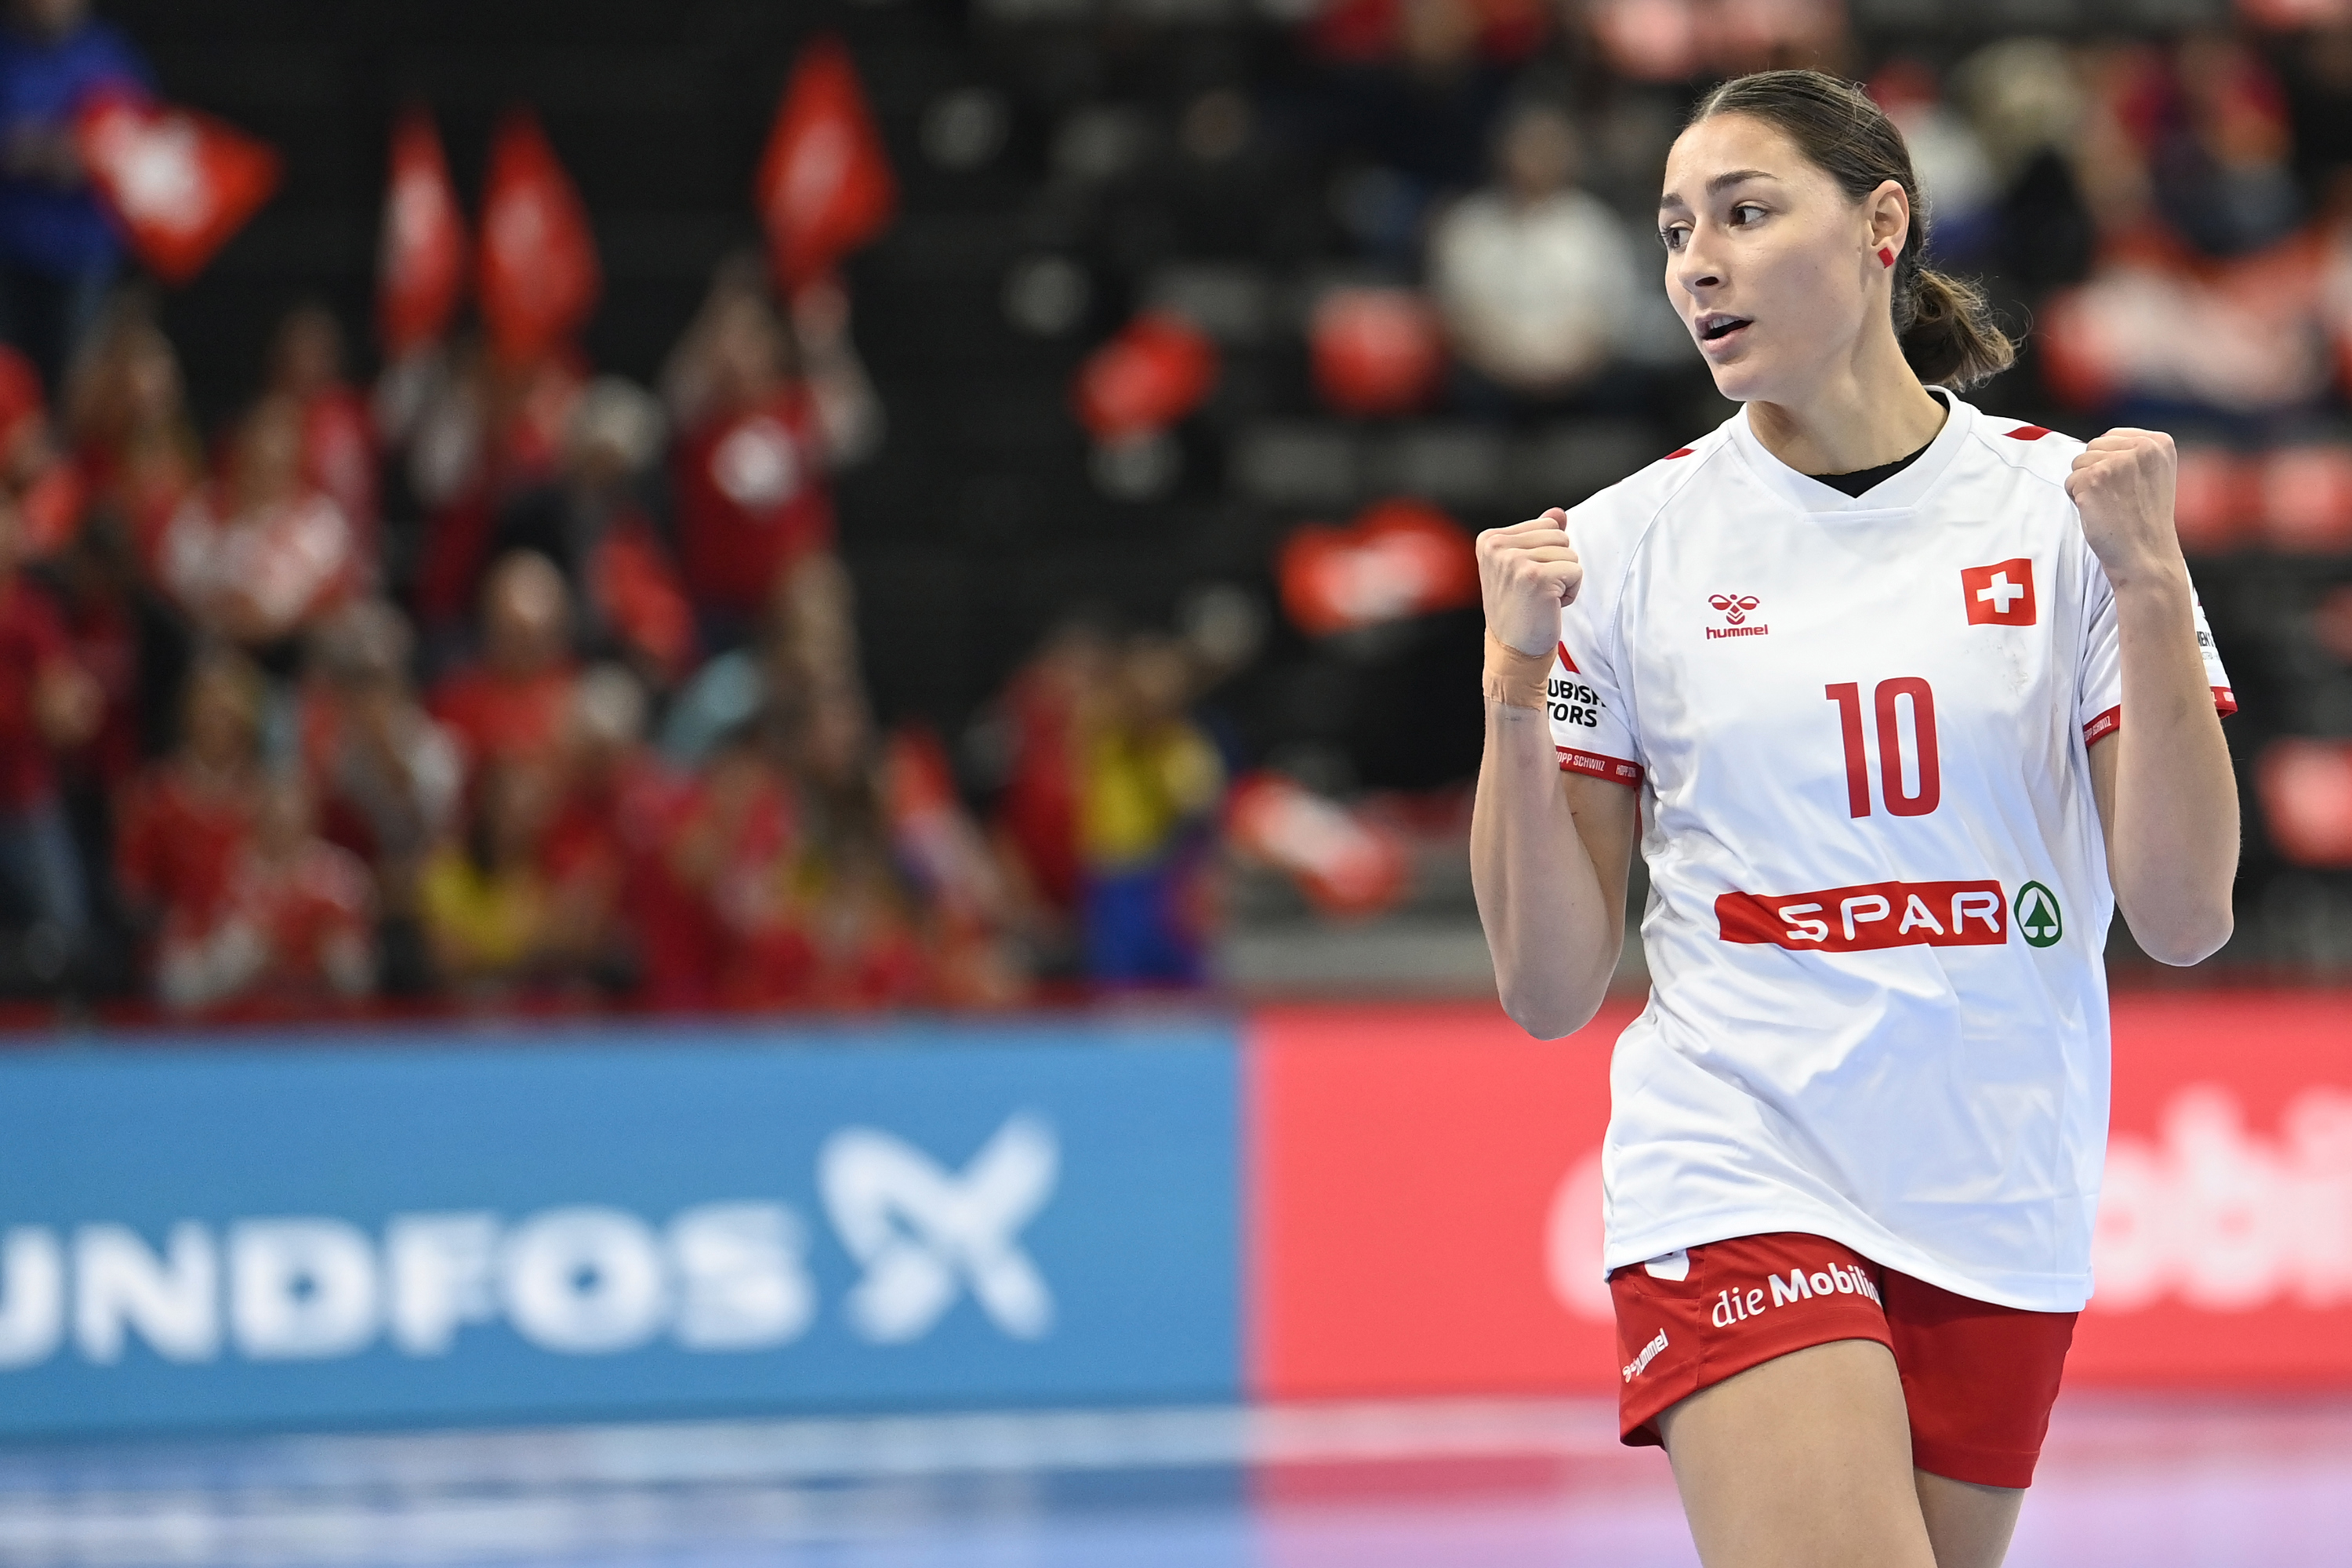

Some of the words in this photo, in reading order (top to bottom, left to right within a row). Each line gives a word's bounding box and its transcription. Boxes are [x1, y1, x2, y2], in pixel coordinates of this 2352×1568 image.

[1706, 624, 1769, 640] hummel
[1555, 752, 1573, 764] OPP
[1824, 676, 1940, 819] 10
[1777, 891, 2001, 943] SPAR
[1711, 1286, 1767, 1329] die
